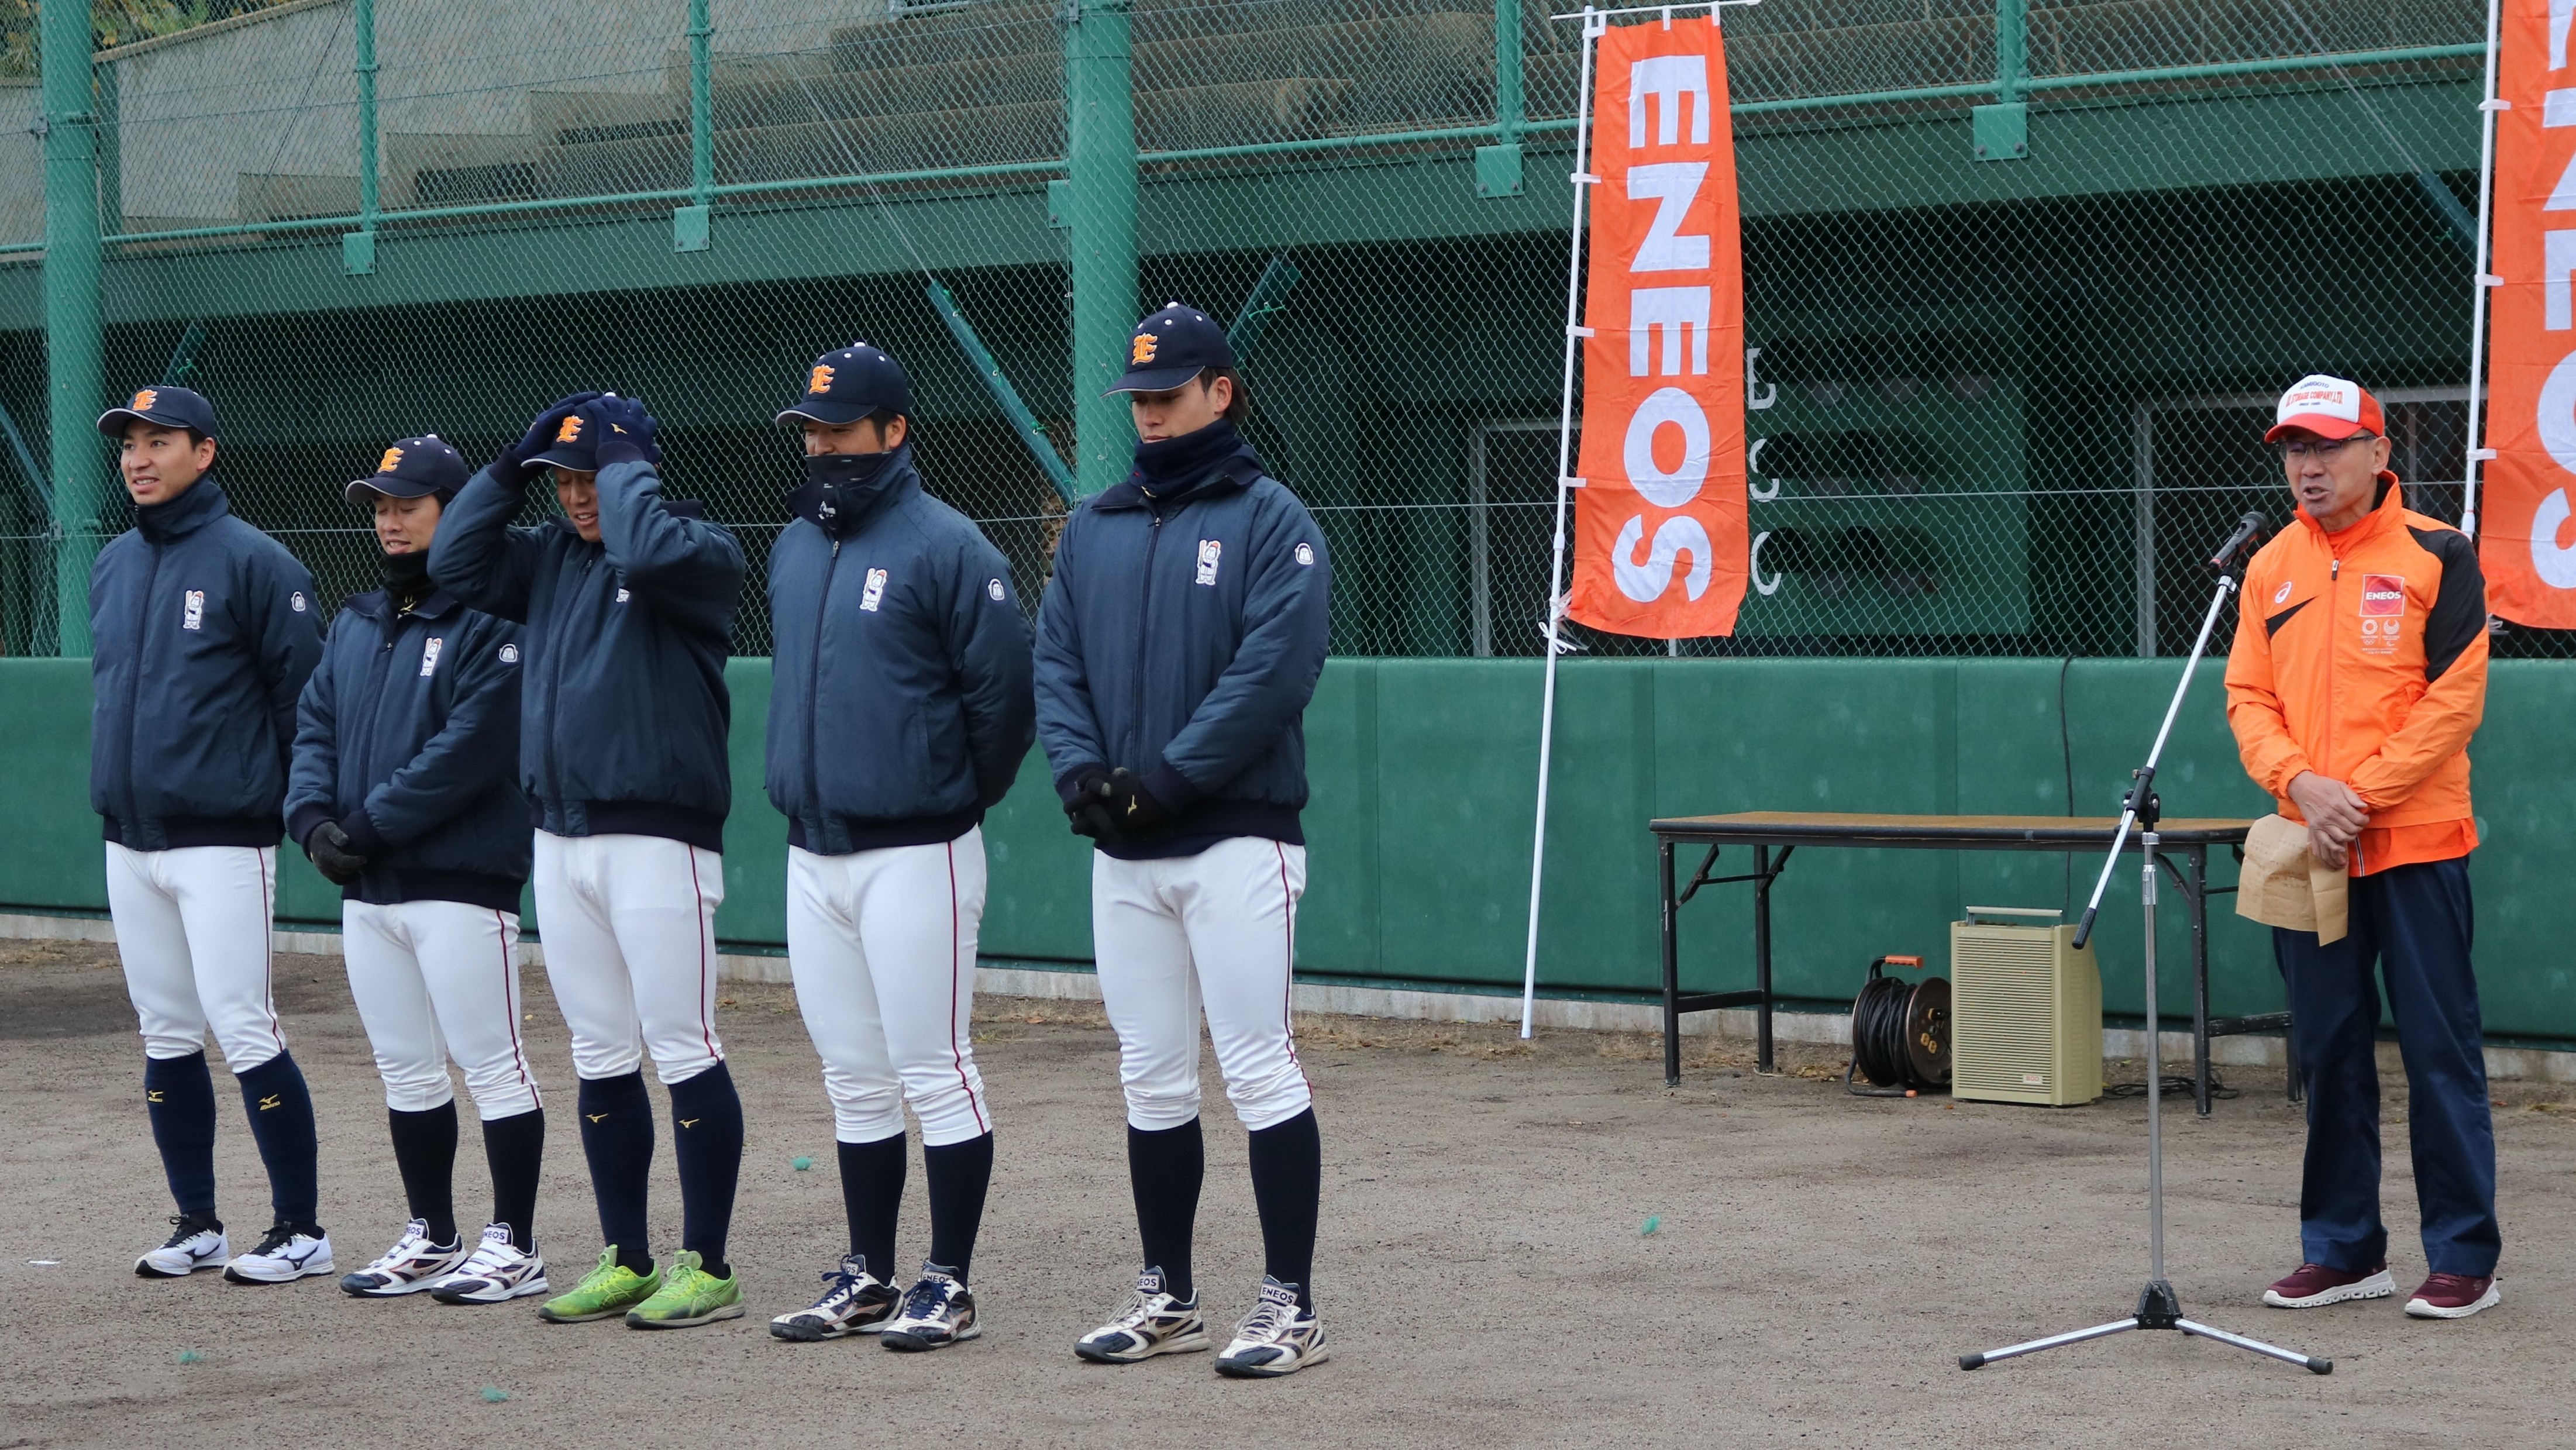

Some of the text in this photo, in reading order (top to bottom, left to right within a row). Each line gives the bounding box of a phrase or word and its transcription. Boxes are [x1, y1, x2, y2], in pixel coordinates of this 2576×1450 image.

[1612, 54, 1711, 603] ENEOS
[1131, 332, 1158, 366] E
[808, 363, 835, 395] E
[132, 388, 158, 411] E
[556, 415, 584, 443] E
[377, 446, 404, 473] E
[2365, 591, 2402, 600] ENEOS
[923, 1274, 950, 1283] ENEO
[1262, 1287, 1294, 1303] ENEOS
